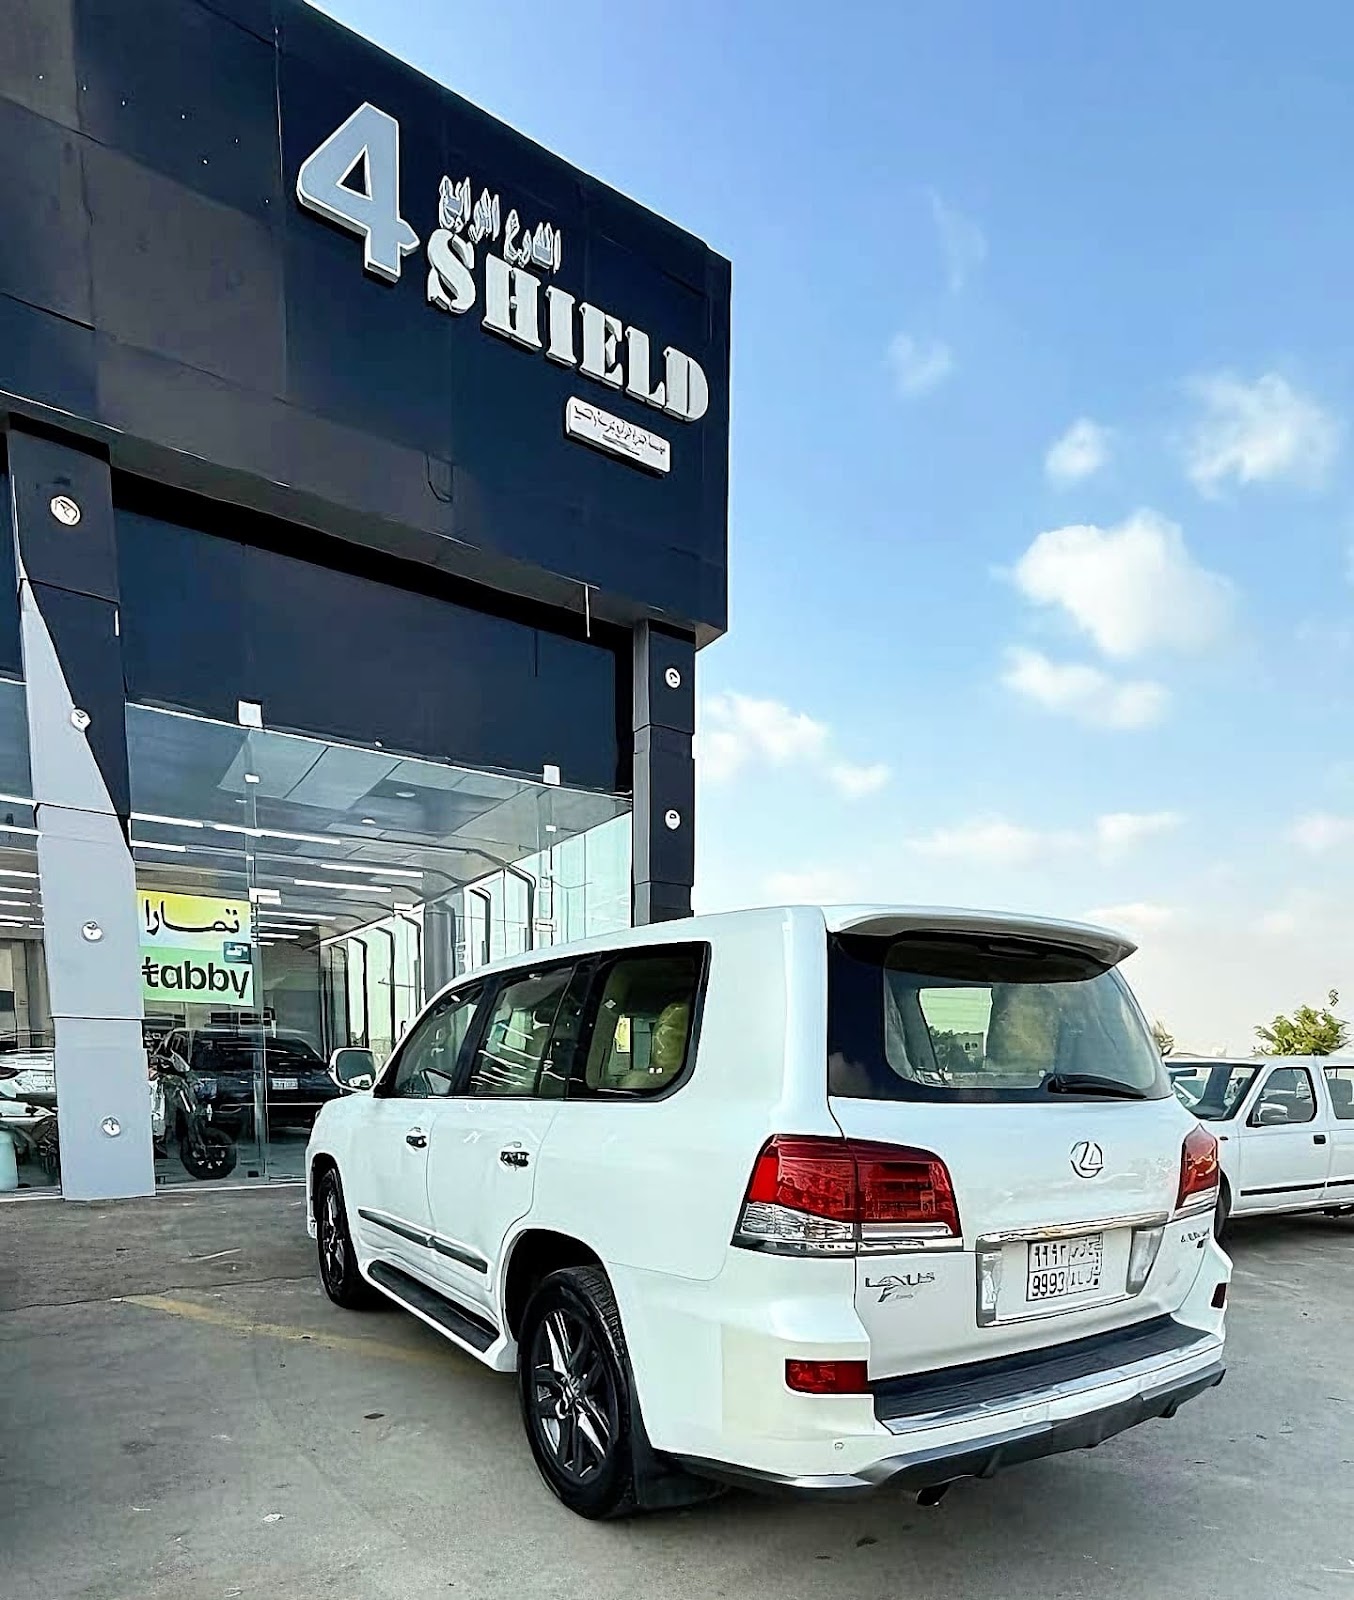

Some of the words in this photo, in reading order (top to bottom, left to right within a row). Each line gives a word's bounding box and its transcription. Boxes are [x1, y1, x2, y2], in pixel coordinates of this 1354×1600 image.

[296, 102, 420, 283] 4
[427, 229, 709, 421] SHIELD
[145, 899, 240, 936] تمارا
[142, 956, 249, 999] tabby
[1032, 1271, 1065, 1297] 9993
